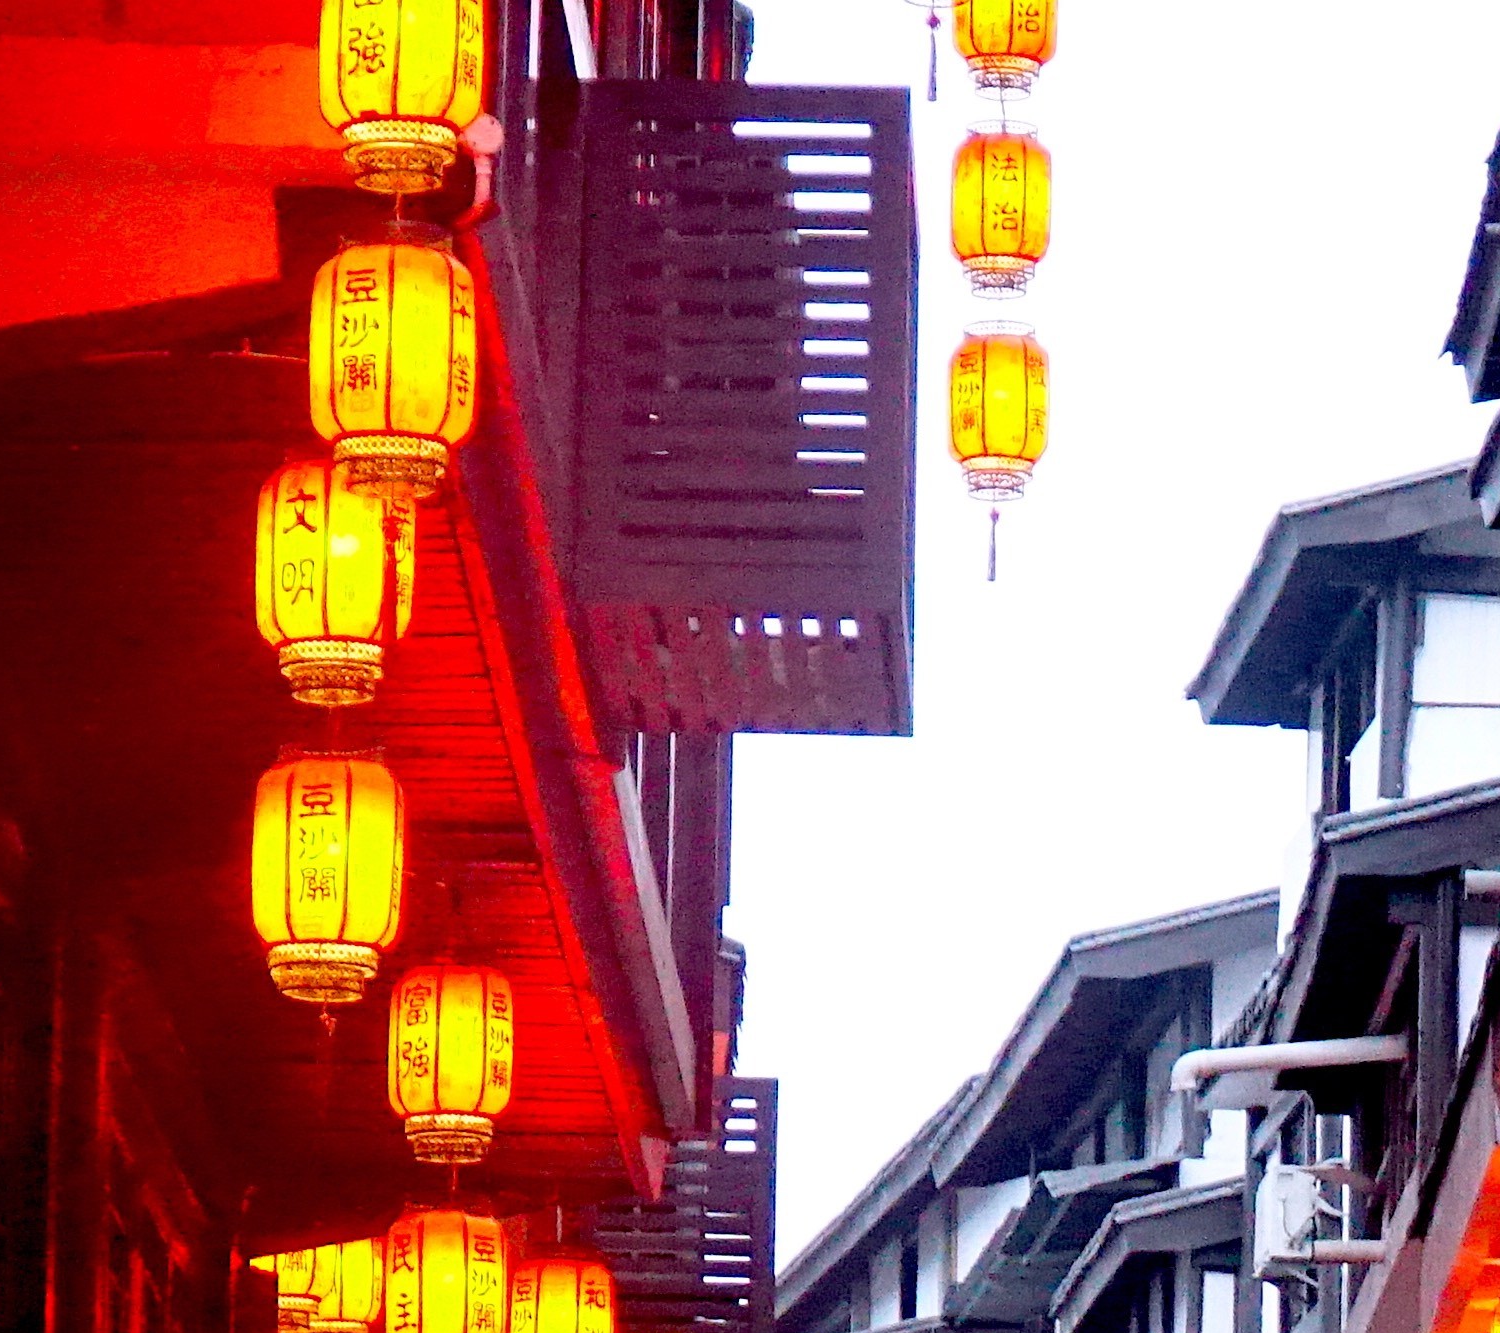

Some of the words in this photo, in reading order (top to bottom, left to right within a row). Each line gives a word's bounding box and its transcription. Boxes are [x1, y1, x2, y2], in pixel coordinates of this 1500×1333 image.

[348, 0, 386, 75] 強
[460, 0, 480, 92] 沙關
[990, 152, 1019, 231] 法治
[339, 269, 380, 393] 豆沙關
[282, 488, 318, 606] 文明
[298, 783, 338, 904] 豆沙關
[403, 983, 432, 1079] 富強
[488, 992, 510, 1089] 豆沙關
[394, 1235, 416, 1333] 民主
[470, 1235, 498, 1333] 豆沙關
